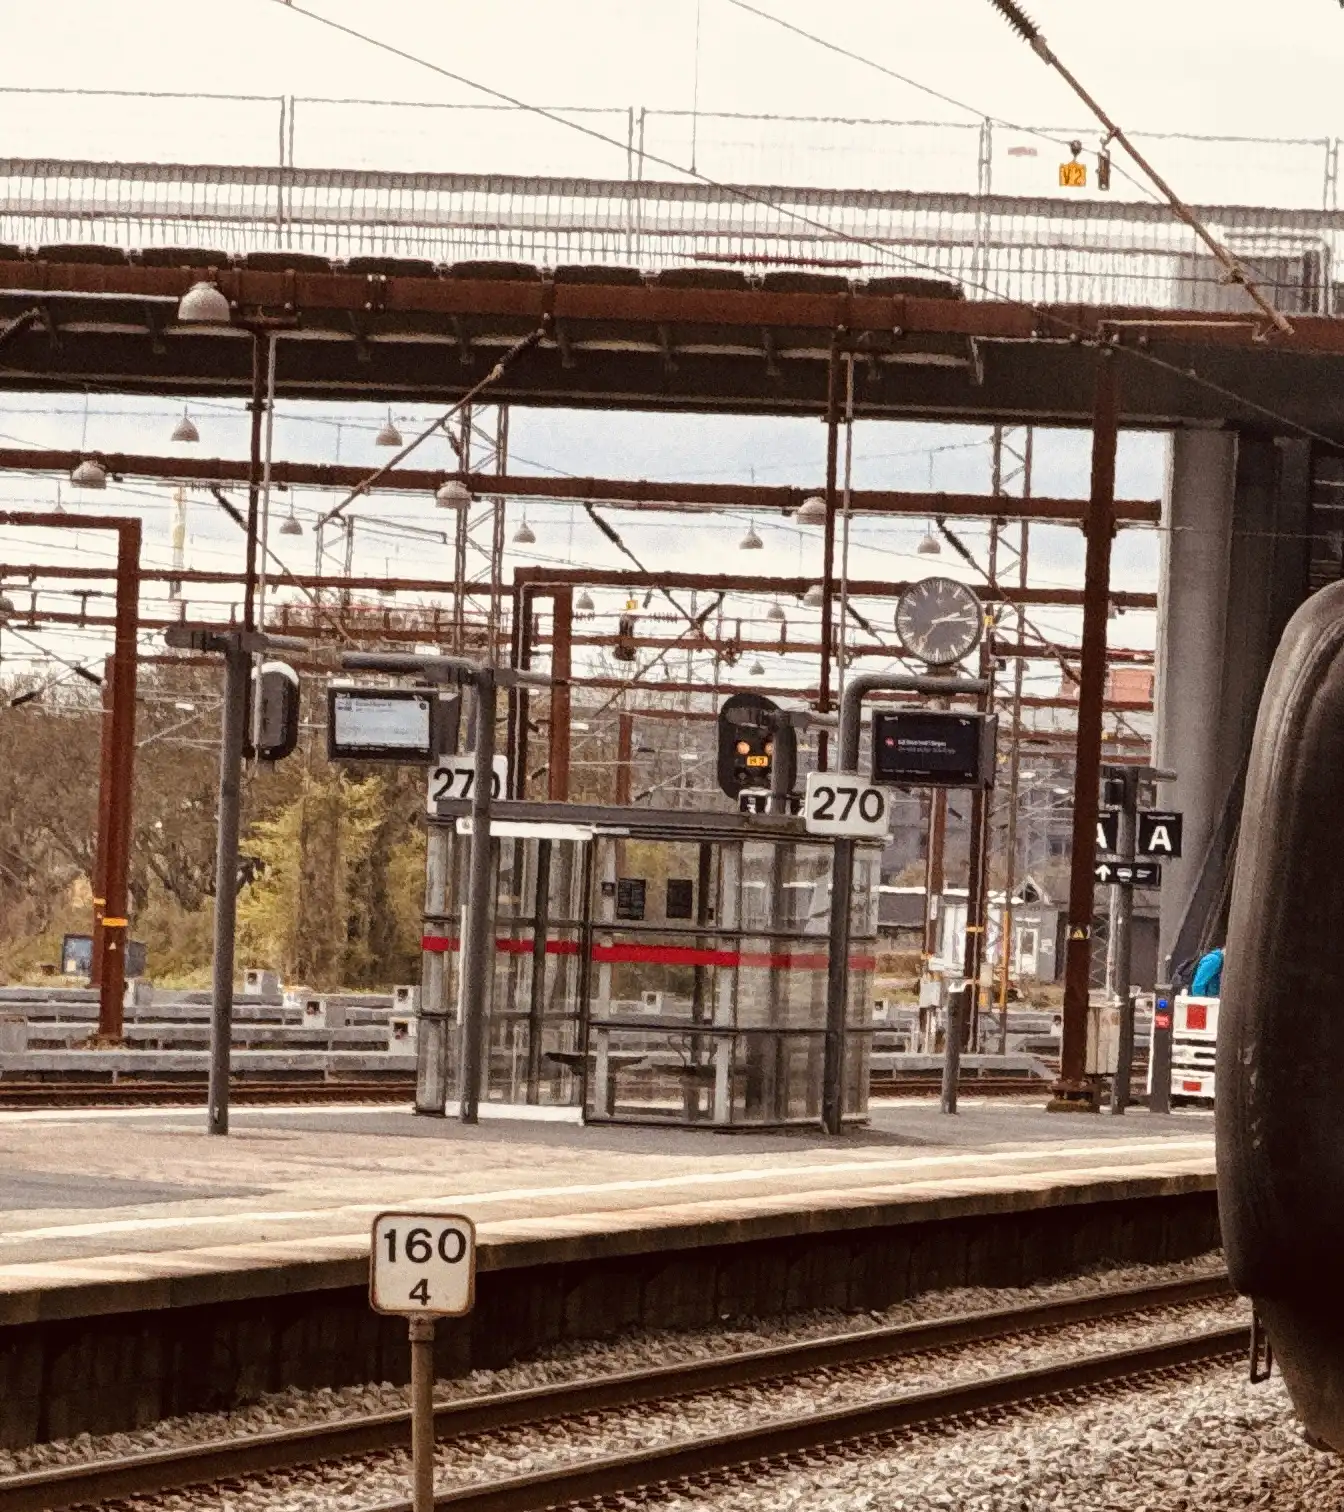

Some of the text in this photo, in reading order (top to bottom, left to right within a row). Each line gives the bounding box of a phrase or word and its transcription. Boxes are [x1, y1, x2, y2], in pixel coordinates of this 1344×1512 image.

[813, 786, 884, 823] 270
[1148, 825, 1172, 851] A
[384, 1228, 467, 1264] 160
[408, 1278, 432, 1306] 4
